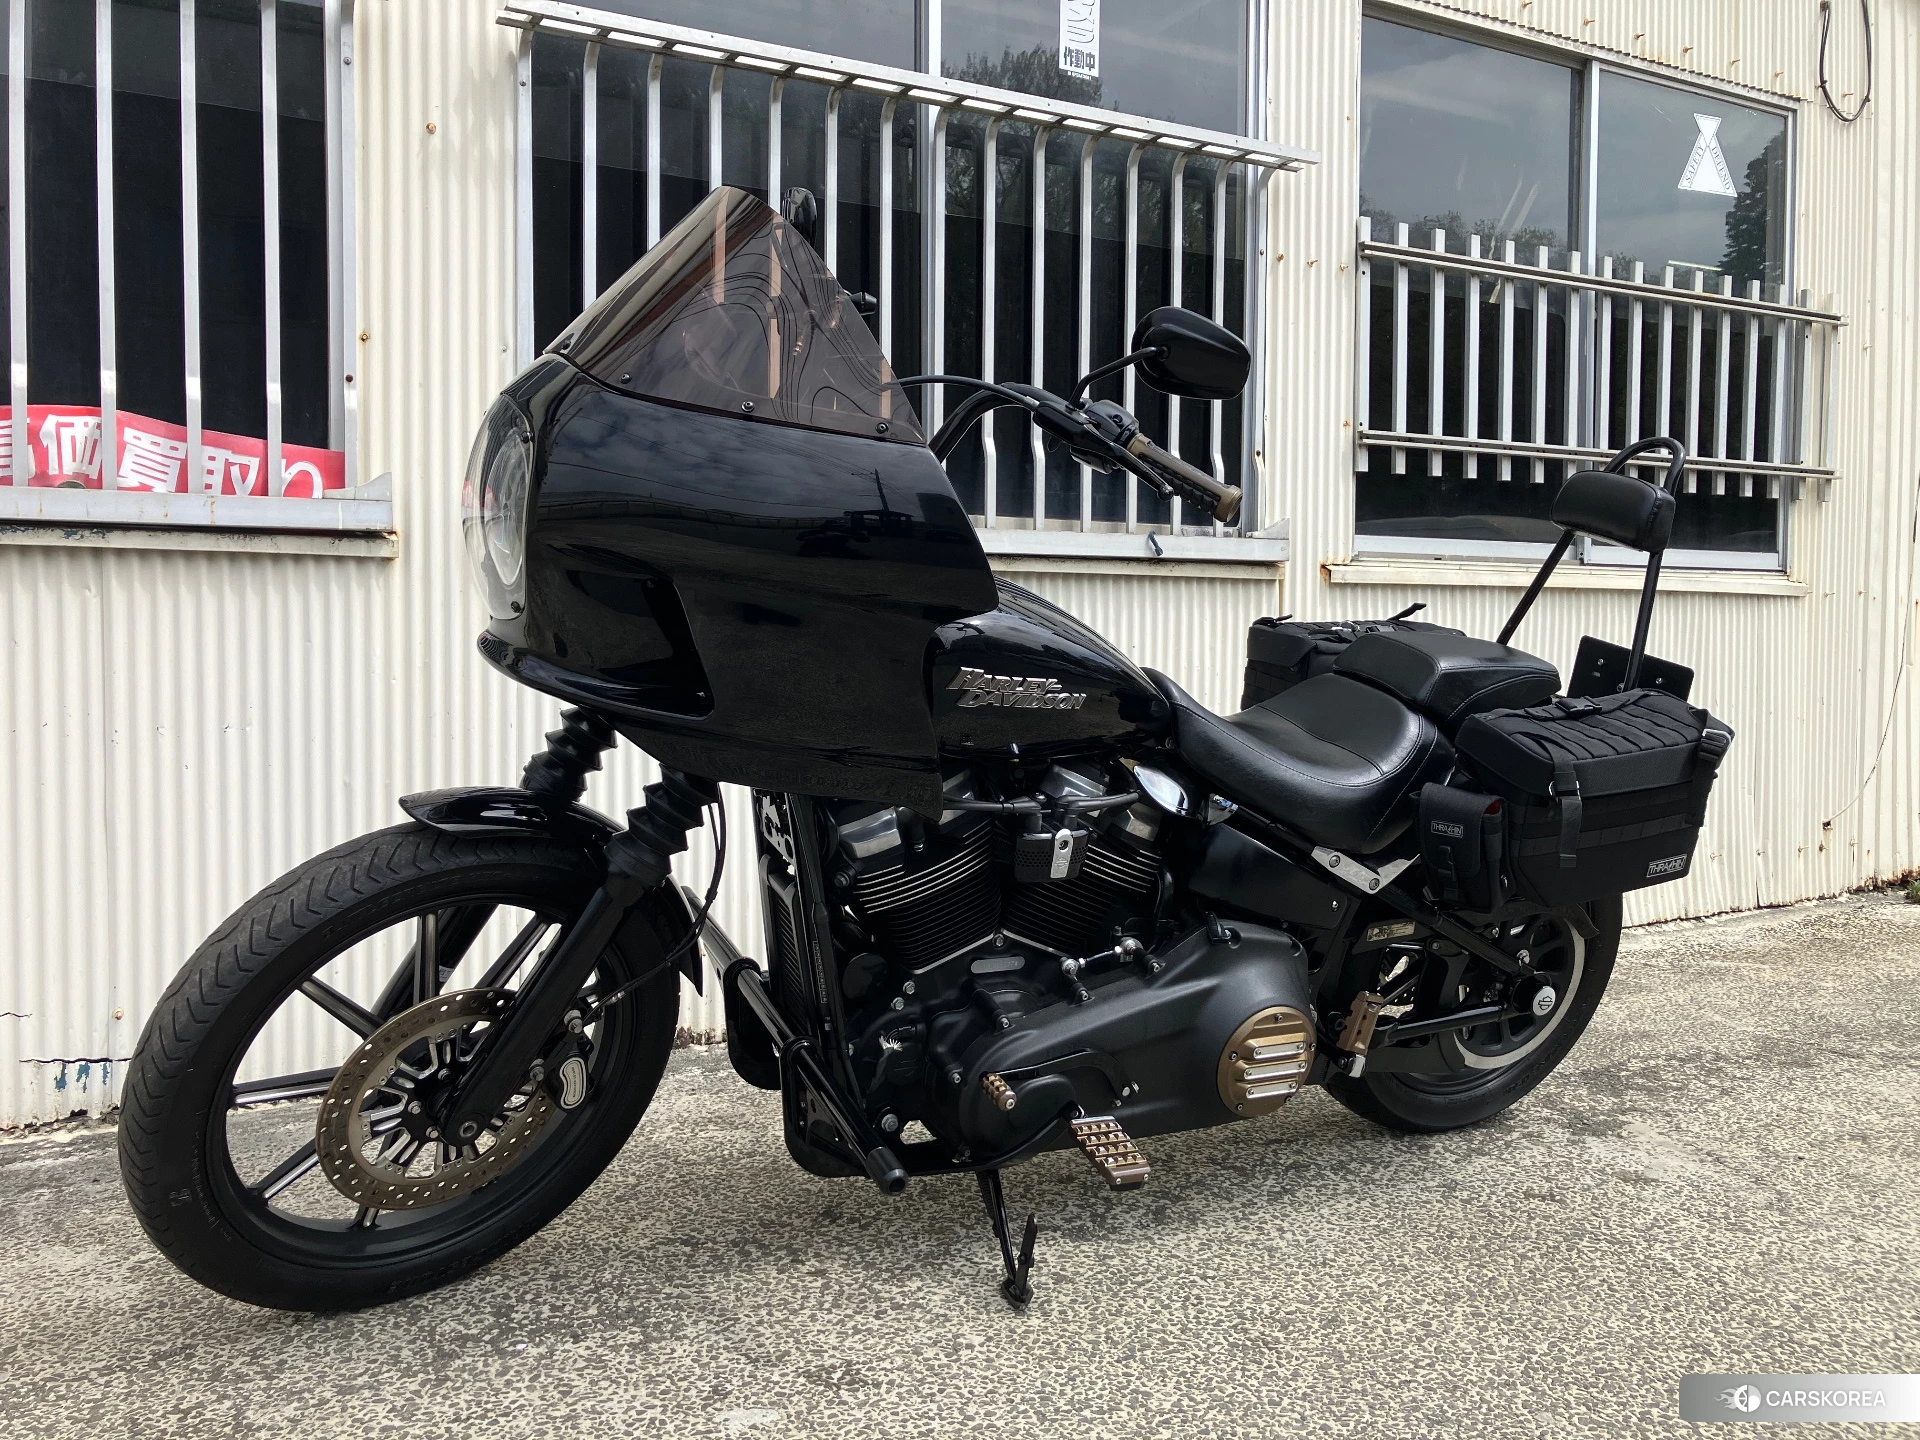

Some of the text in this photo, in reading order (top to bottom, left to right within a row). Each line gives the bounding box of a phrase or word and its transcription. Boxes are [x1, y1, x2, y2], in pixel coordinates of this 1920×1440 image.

[1063, 46, 1096, 71] 作動中
[1685, 146, 1704, 184] SAFETY
[1711, 146, 1731, 190] DEFEND
[956, 689, 1087, 709] DAVIDSON
